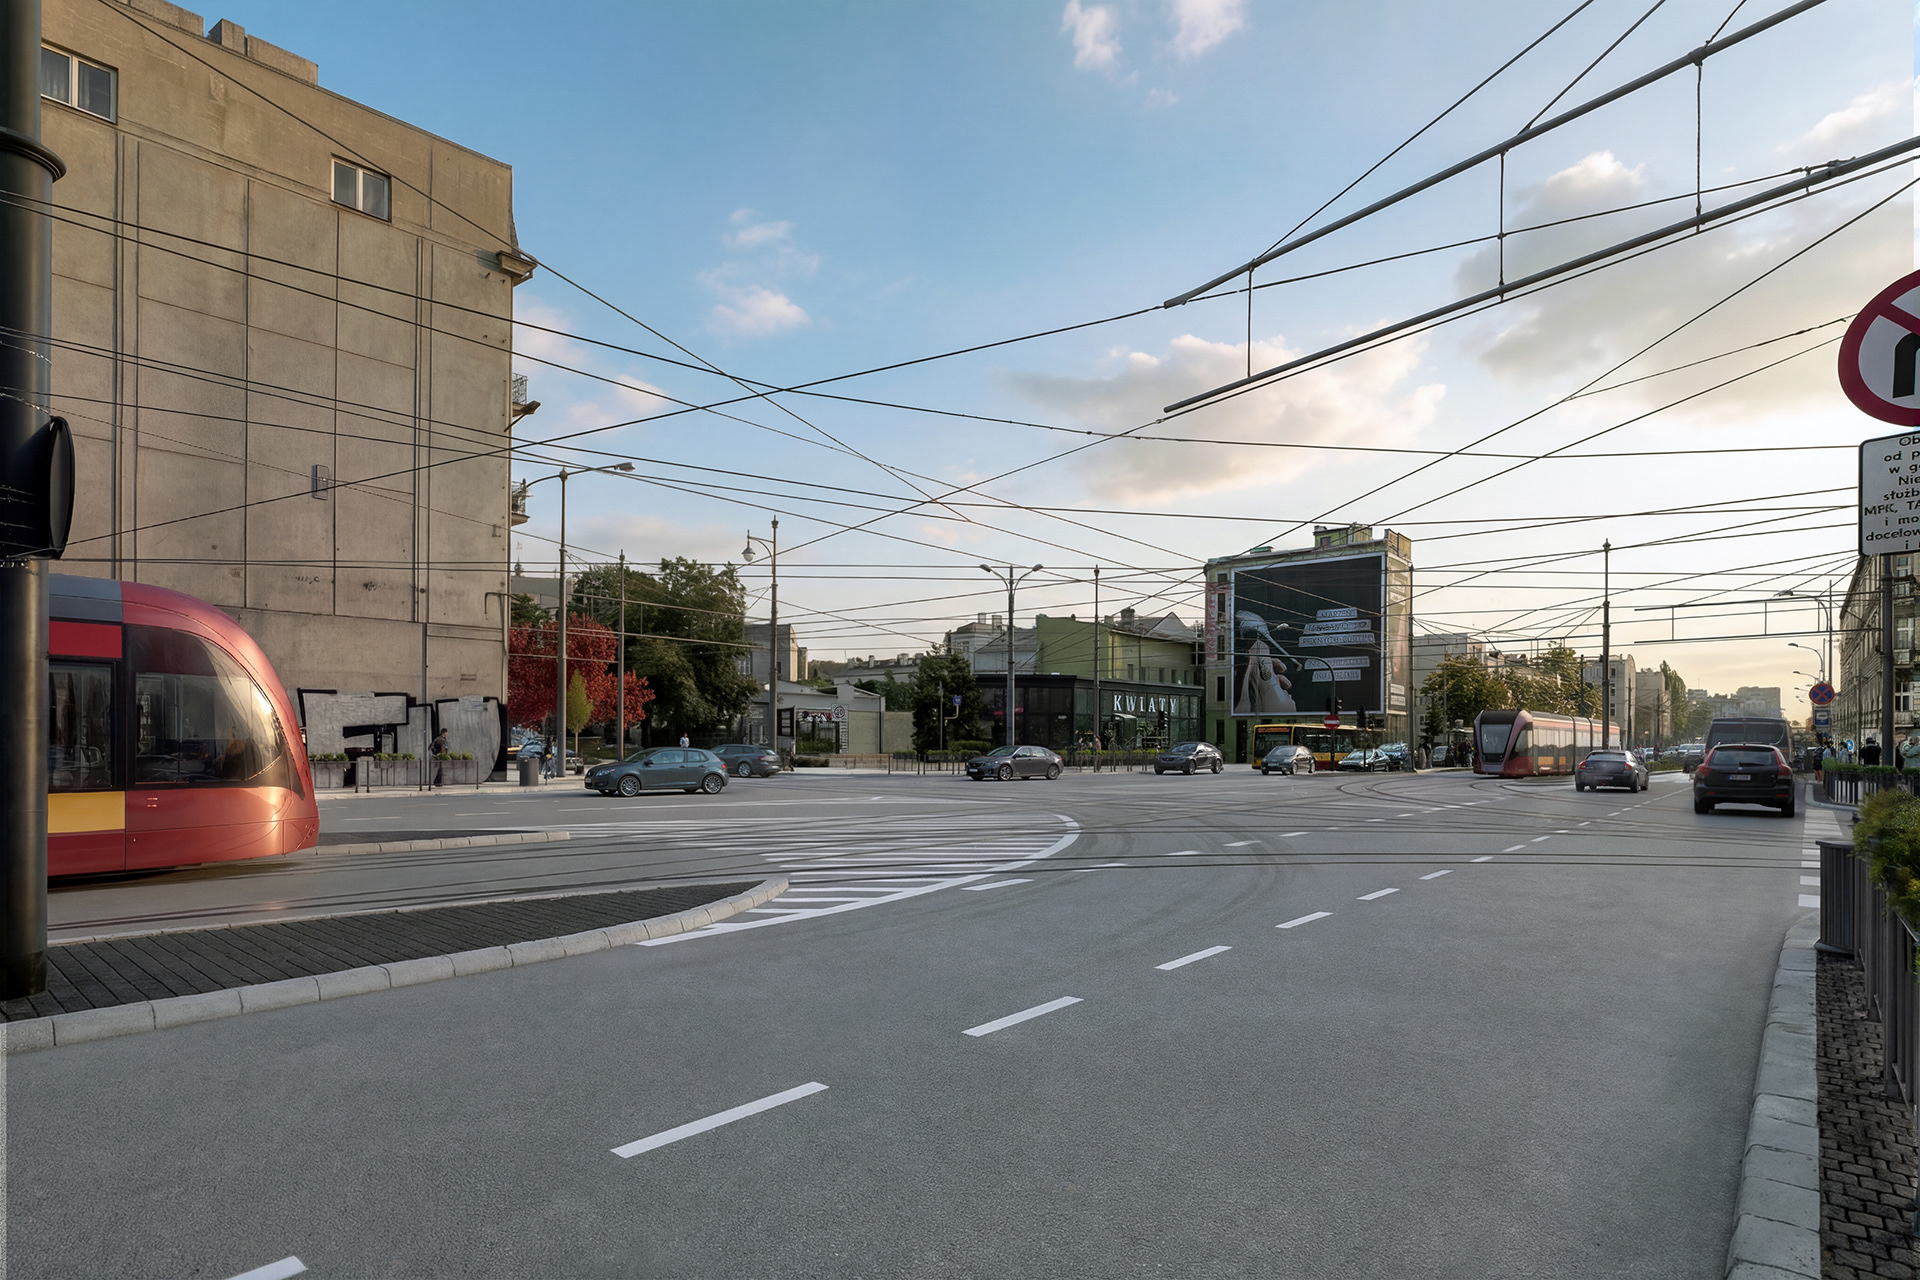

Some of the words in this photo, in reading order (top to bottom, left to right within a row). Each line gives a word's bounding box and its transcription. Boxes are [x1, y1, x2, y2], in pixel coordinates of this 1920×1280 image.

[1884, 451, 1902, 462] od
[1889, 466, 1900, 474] w
[1909, 464, 1920, 474] g
[1898, 474, 1920, 486] Nie
[1883, 488, 1920, 501] służb
[1885, 517, 1888, 526] i
[1898, 516, 1920, 525] mo
[1905, 540, 1908, 549] i
[1114, 695, 1177, 713] KWIATY
